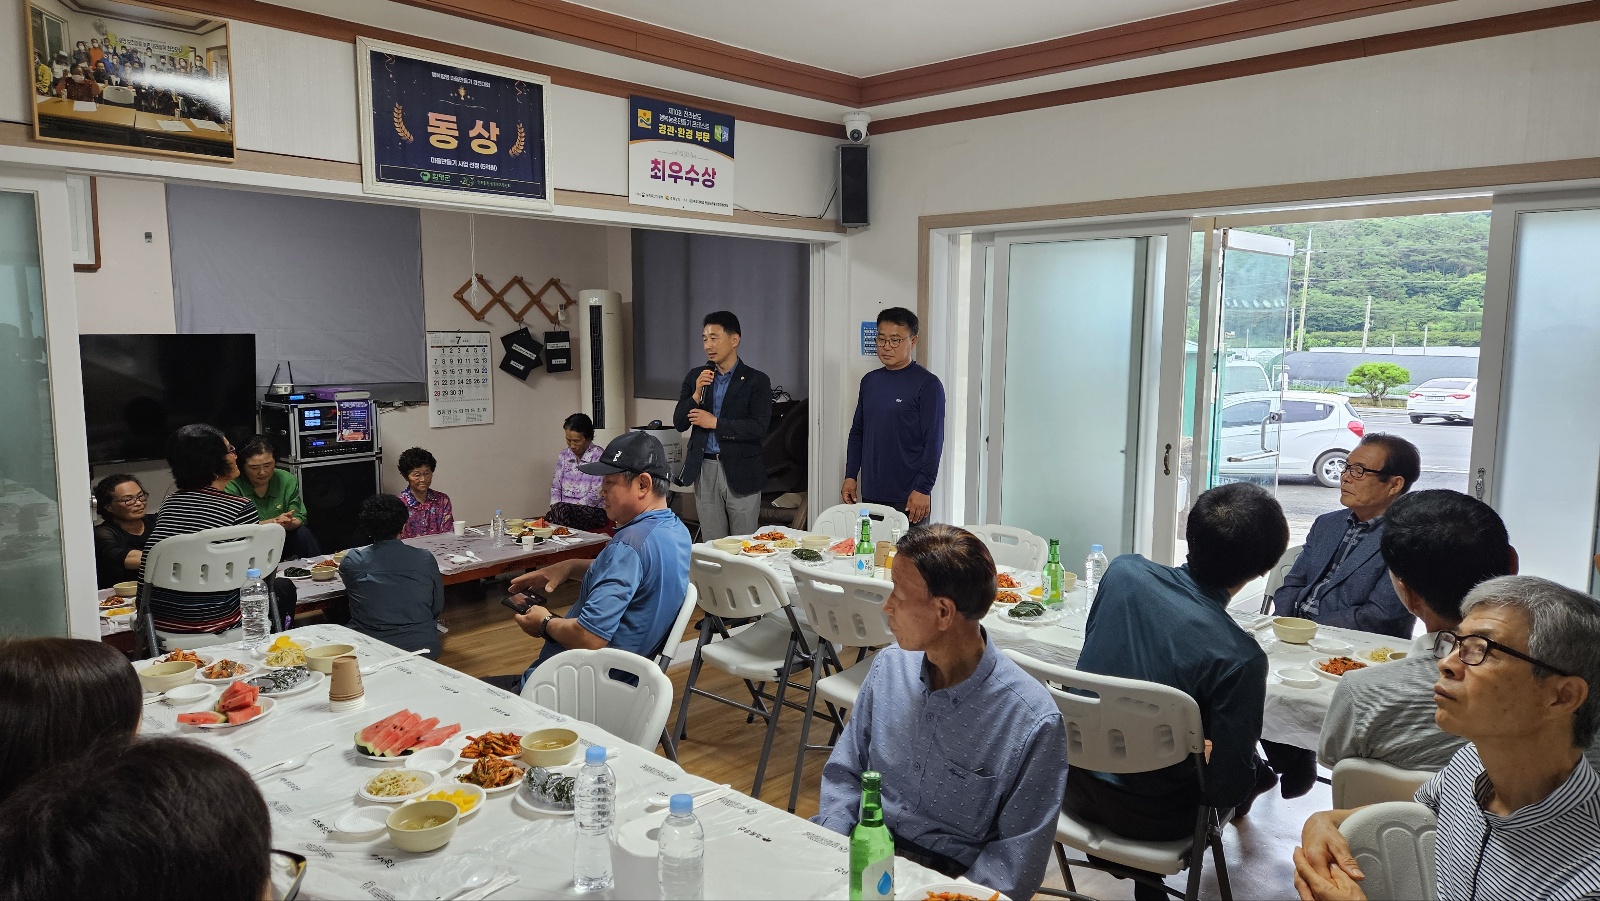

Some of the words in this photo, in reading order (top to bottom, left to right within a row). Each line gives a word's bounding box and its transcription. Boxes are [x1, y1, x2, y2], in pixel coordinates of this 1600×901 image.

[427, 111, 459, 150] 동
[468, 119, 500, 155] 상
[695, 130, 711, 143] 부문
[650, 158, 717, 189] 최우수상
